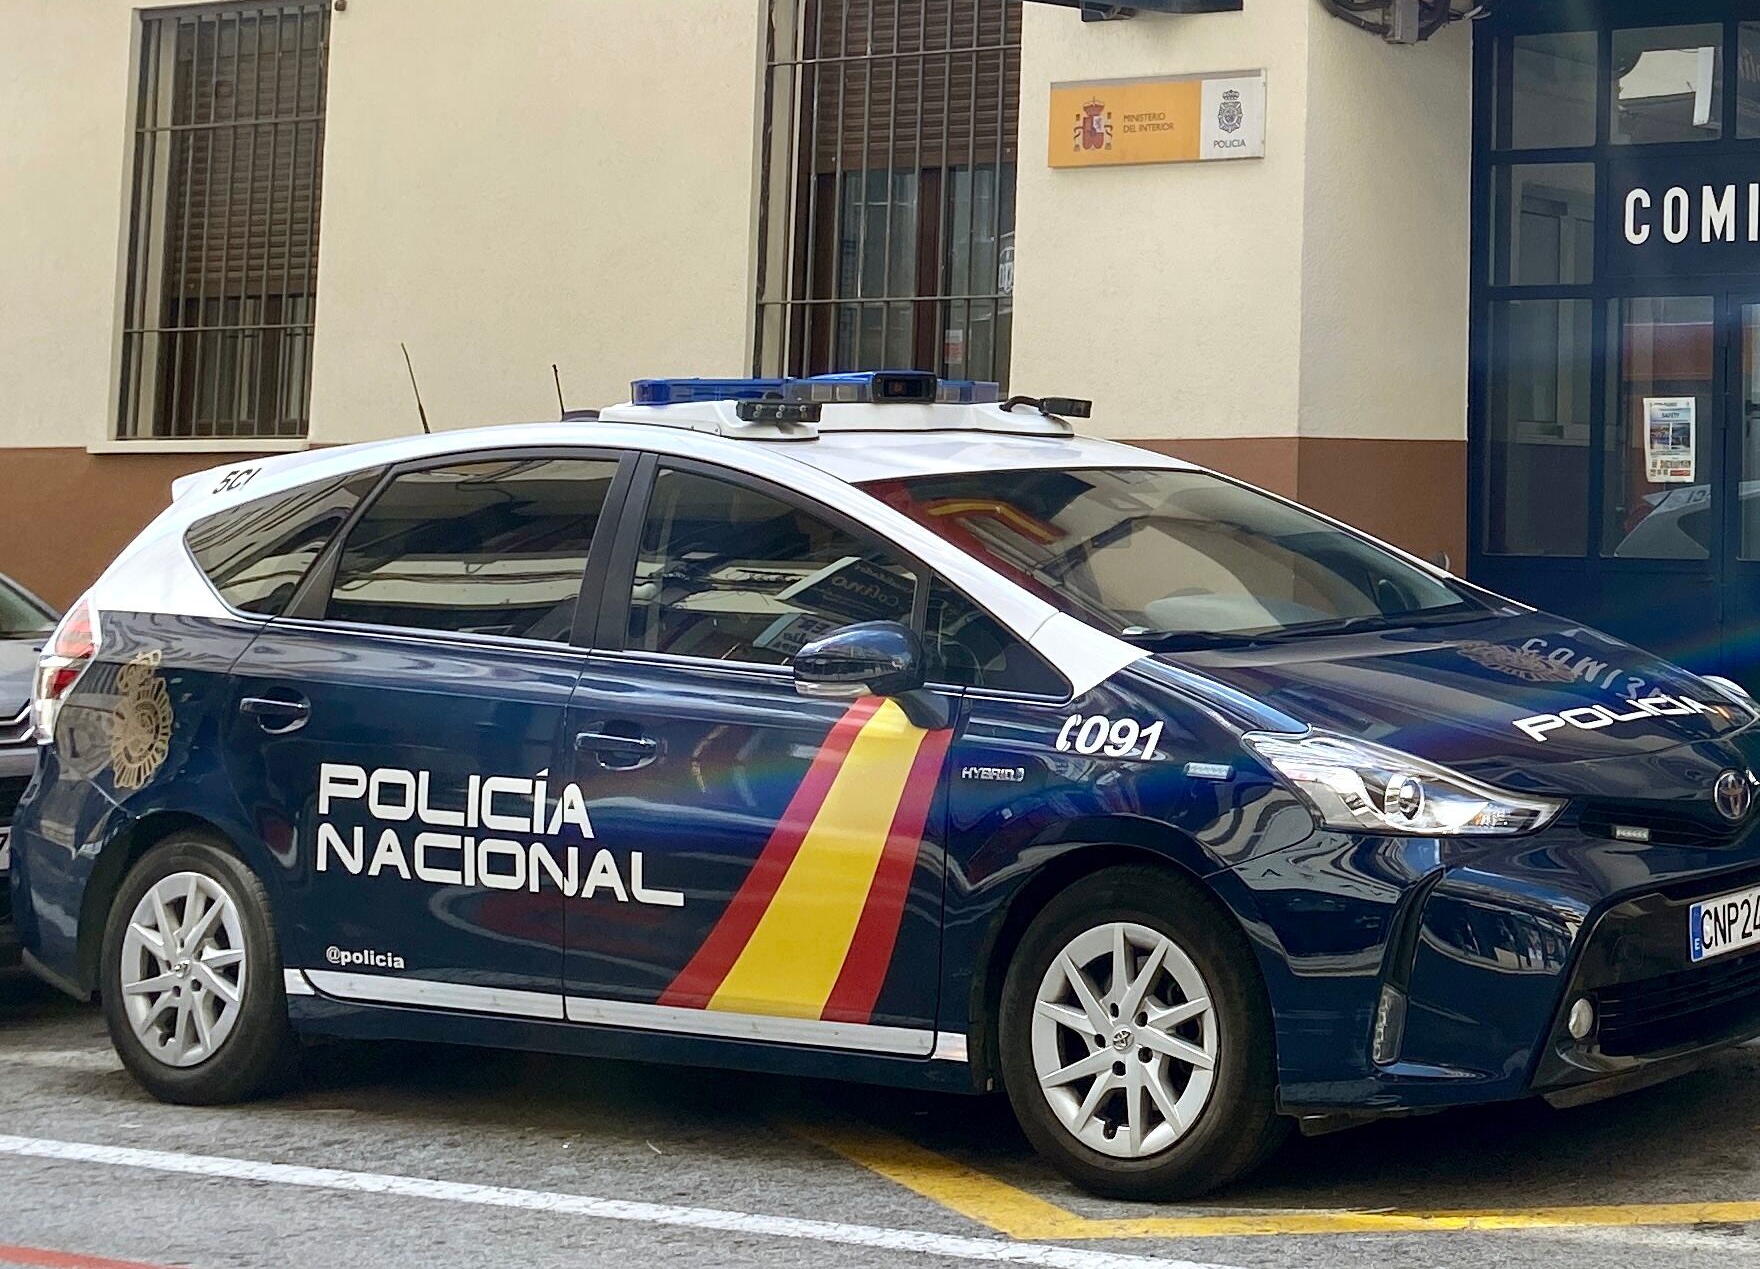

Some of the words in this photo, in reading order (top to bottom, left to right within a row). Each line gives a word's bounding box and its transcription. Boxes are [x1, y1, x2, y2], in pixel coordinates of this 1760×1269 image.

[1123, 113, 1166, 122] MINISTERIO
[1123, 124, 1136, 133] DEL
[1139, 123, 1175, 133] INTERIOR
[1075, 715, 1165, 761] 091
[318, 763, 595, 839] POLICÍA
[316, 822, 685, 907] NACIONAL
[325, 946, 405, 969] @policia
